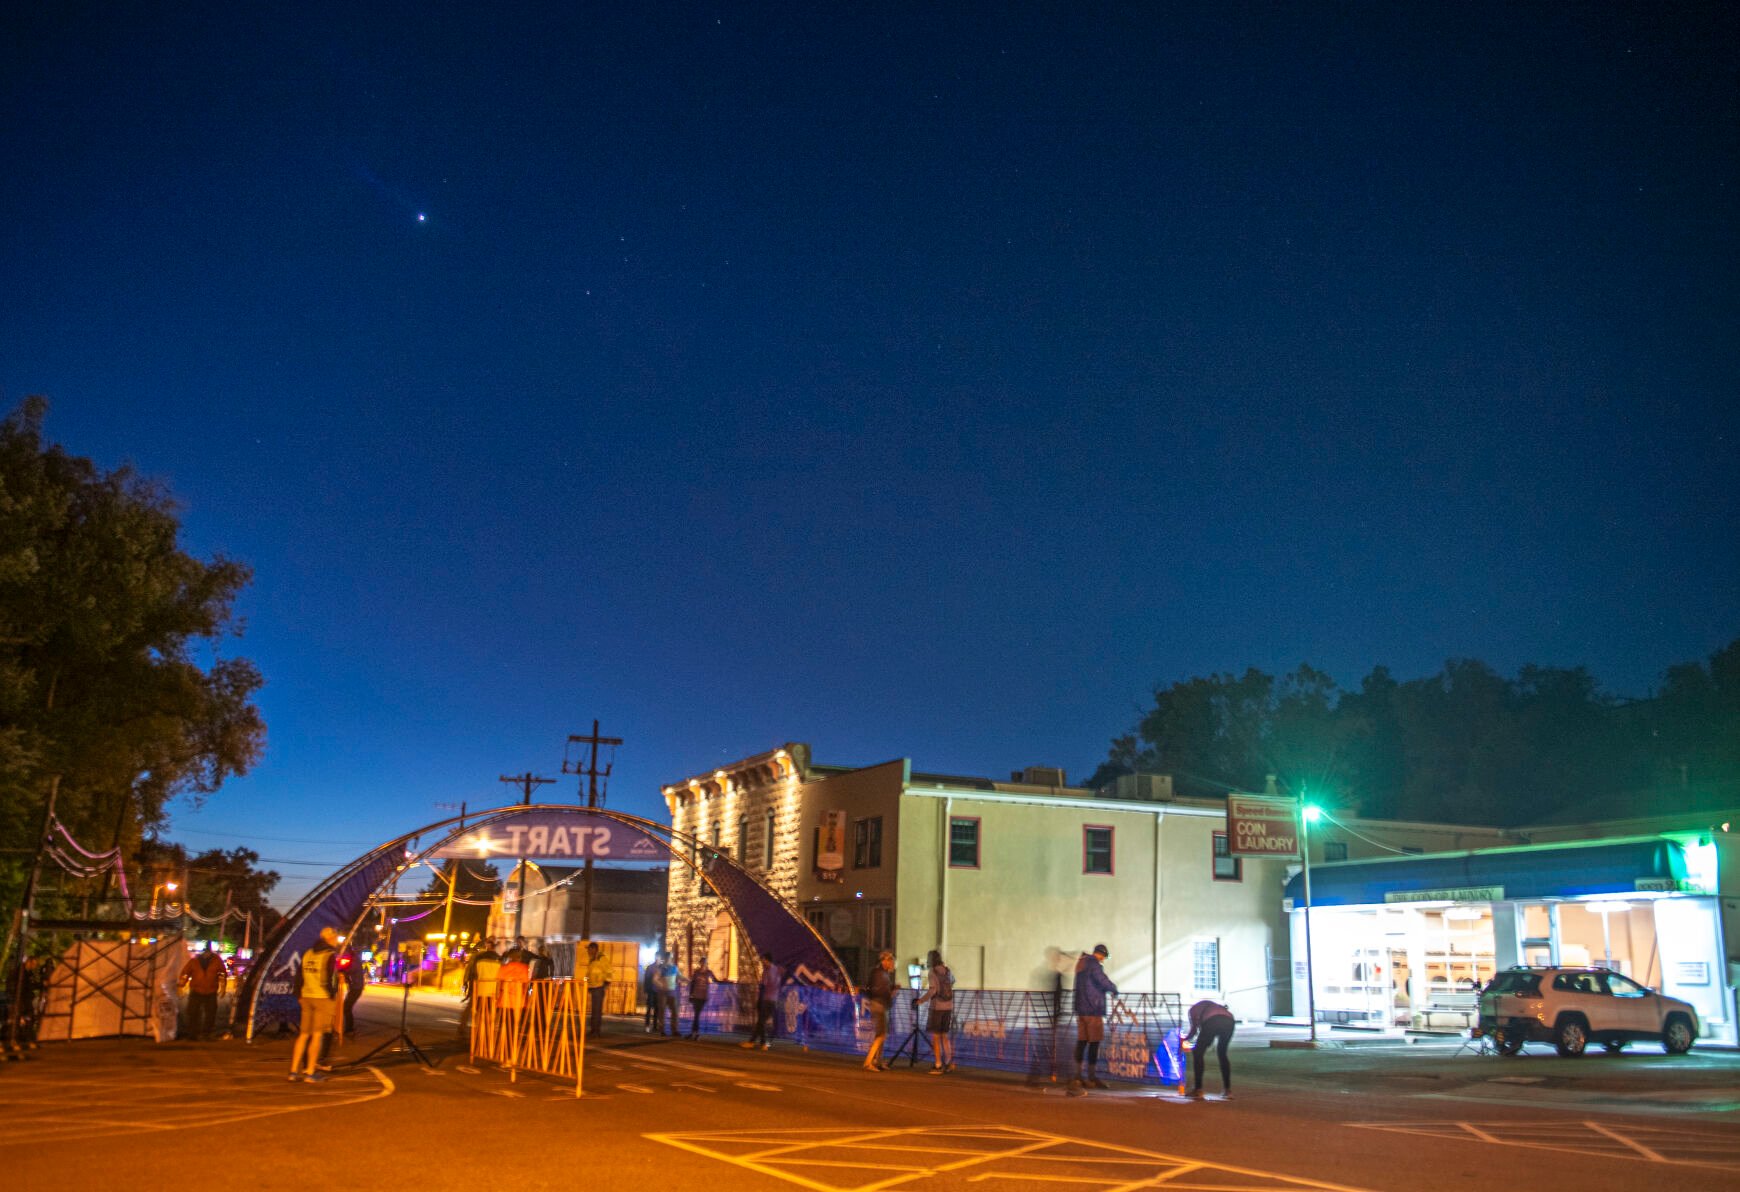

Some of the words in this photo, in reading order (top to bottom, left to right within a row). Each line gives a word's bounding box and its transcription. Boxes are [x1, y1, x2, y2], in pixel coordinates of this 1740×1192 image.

[1237, 822, 1266, 836] COIN
[1237, 835, 1294, 851] LAUNDRY
[263, 983, 290, 995] PIKES
